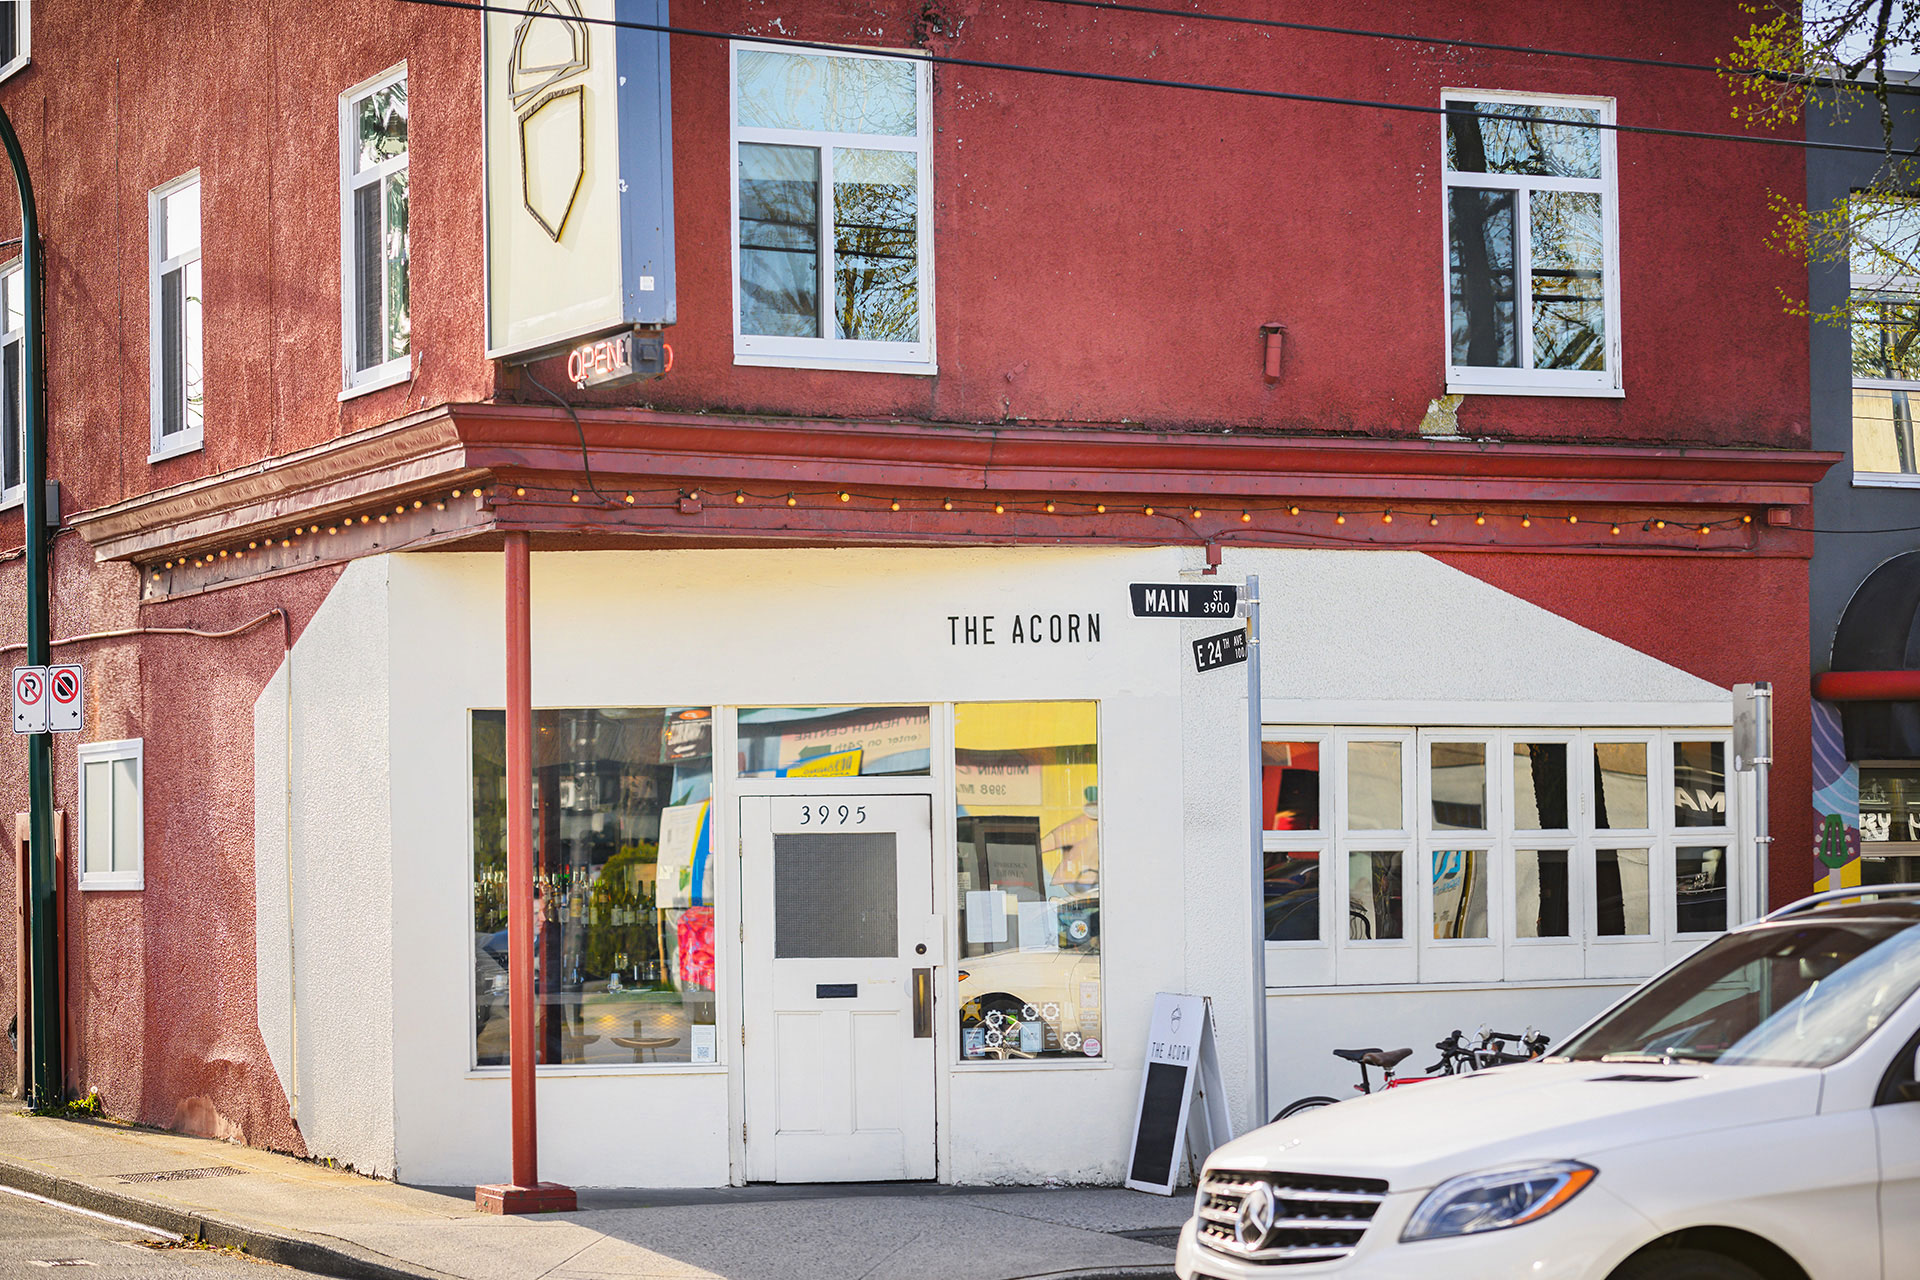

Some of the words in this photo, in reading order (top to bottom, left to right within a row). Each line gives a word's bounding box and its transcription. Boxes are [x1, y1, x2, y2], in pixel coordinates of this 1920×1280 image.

[568, 338, 625, 383] OPEN
[1145, 589, 1189, 613] MAIN
[1212, 590, 1223, 602] ST
[1203, 602, 1230, 614] 3900
[947, 615, 996, 646] THE
[1012, 613, 1101, 644] ACORN
[1197, 644, 1205, 667] E
[1233, 634, 1243, 647] AVE
[799, 804, 867, 825] 3995
